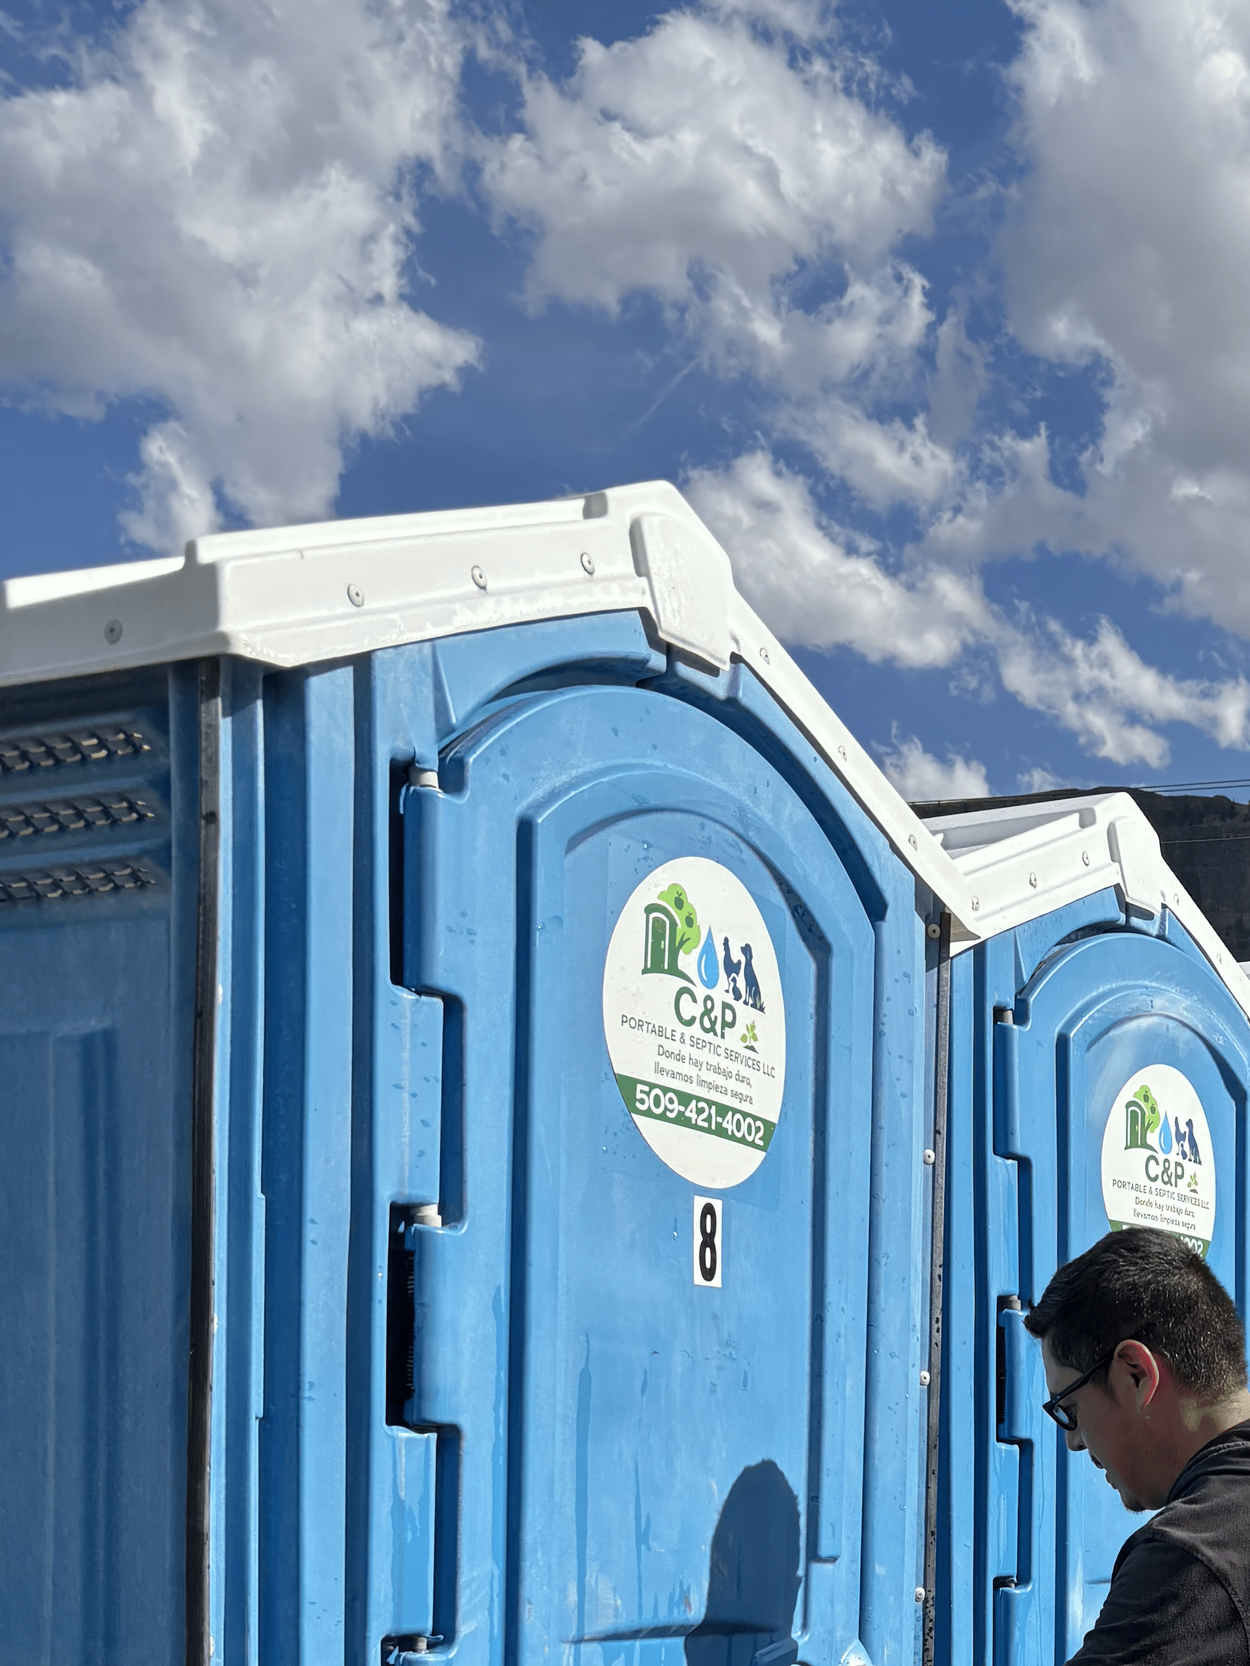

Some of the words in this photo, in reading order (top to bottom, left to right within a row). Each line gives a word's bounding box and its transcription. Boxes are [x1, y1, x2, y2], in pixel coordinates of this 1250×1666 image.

[674, 986, 737, 1040] C&P
[621, 1014, 677, 1041] PORTABLE
[679, 1032, 686, 1045] &
[689, 1035, 722, 1057] SEPTIC
[723, 1047, 761, 1072] SERVICES
[762, 1063, 776, 1079] LLC
[657, 1044, 686, 1063] Donde
[688, 1053, 704, 1071] hay
[705, 1061, 733, 1081] trabajo
[654, 1061, 694, 1085] llevamos
[696, 1073, 728, 1093] limpieza
[730, 1088, 754, 1105] segura
[635, 1083, 765, 1147] 509-421-4002
[1112, 1178, 1147, 1194] PORTABLE
[1148, 1186, 1153, 1195] &
[1154, 1187, 1176, 1200] SEPTIC
[1177, 1192, 1200, 1207] SERVICES
[1145, 1154, 1185, 1188] C&P
[699, 1202, 717, 1282] 8
